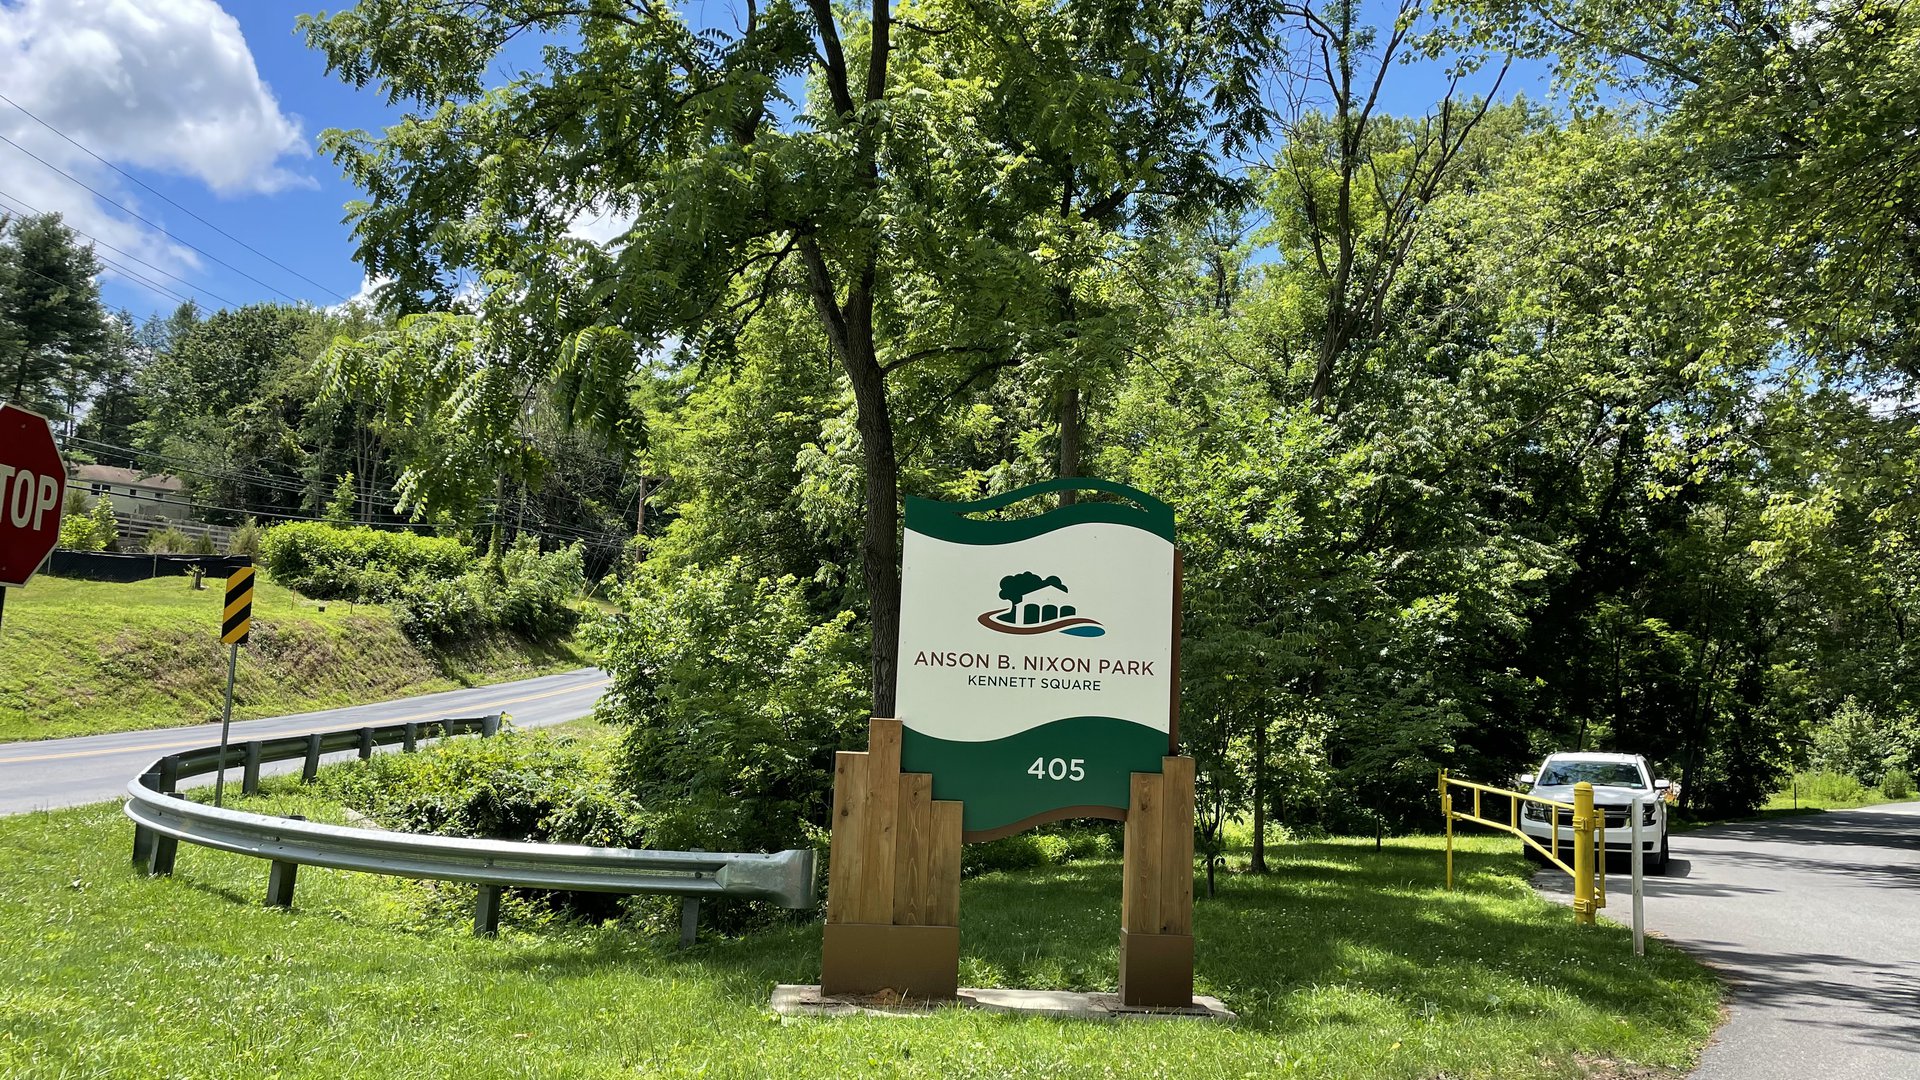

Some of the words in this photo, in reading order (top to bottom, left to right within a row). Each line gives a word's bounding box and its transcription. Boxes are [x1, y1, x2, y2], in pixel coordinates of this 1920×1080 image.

[914, 650, 990, 669] ANSON
[997, 654, 1017, 671] B.
[1023, 655, 1092, 674] NIXON
[1098, 659, 1155, 677] PARK
[967, 674, 1037, 689] KENNETT
[1040, 677, 1102, 691] SQUARE
[1027, 757, 1086, 782] 405
